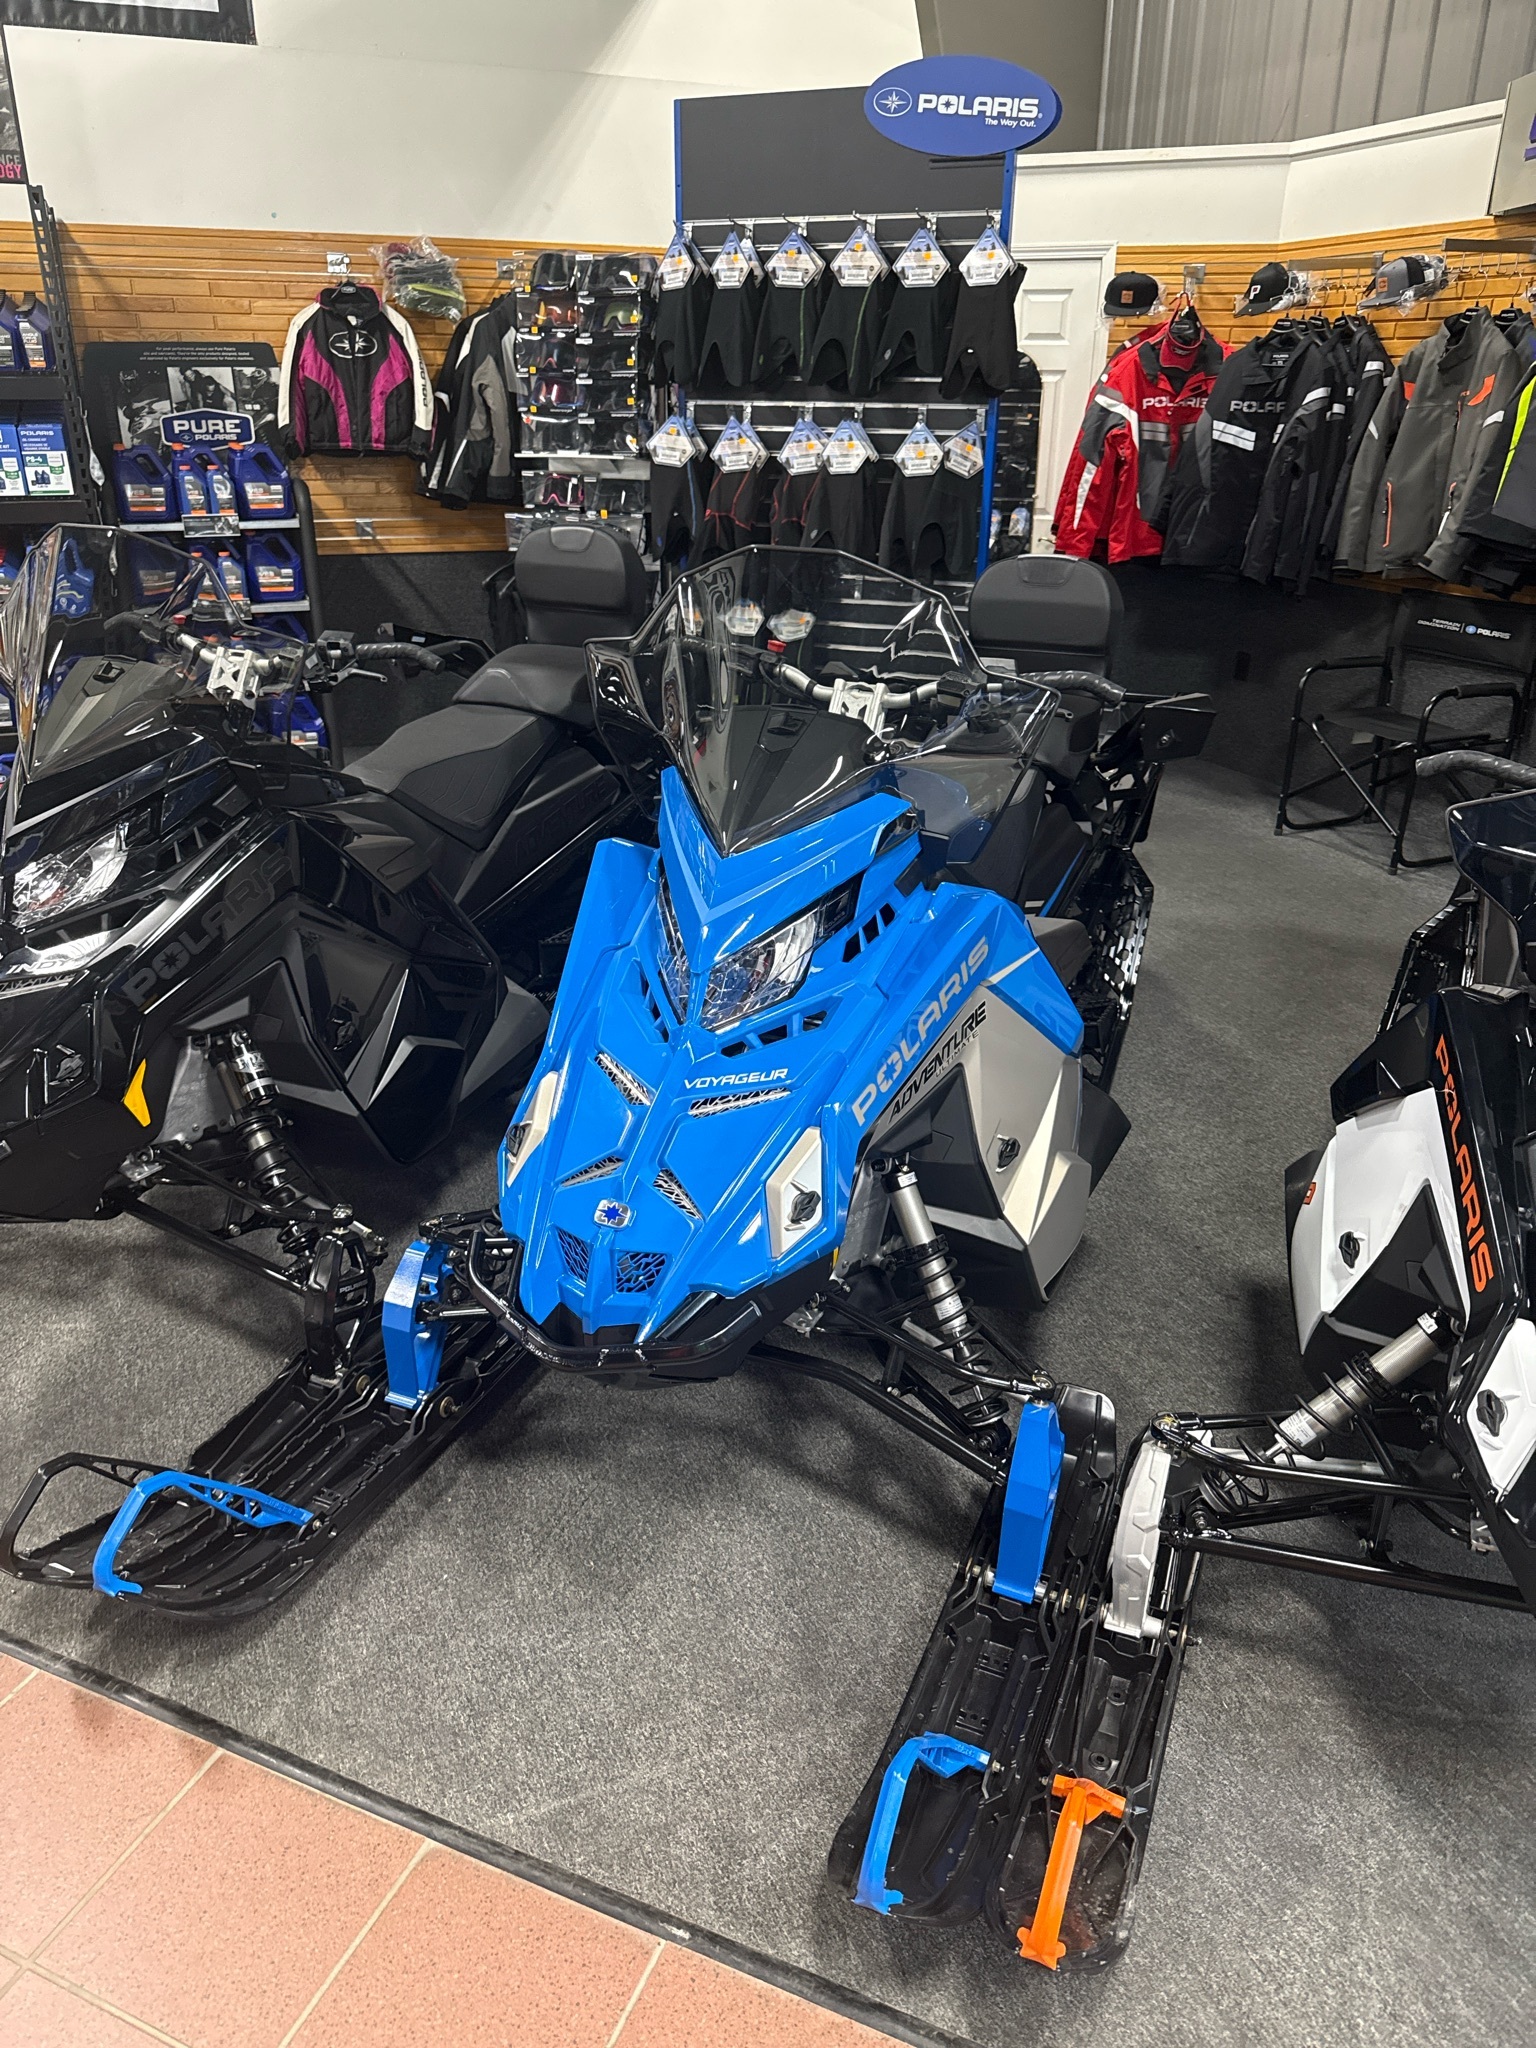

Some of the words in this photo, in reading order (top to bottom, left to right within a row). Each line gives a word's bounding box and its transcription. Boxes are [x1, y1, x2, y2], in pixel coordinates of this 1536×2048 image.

[917, 93, 1040, 118] POLARIS
[985, 118, 998, 126] The
[1000, 118, 1017, 128] Way
[1250, 285, 1261, 299] P
[172, 419, 241, 434] PURE
[194, 433, 238, 441] POLARIS
[1417, 620, 1460, 631] DOMINATION
[1432, 618, 1461, 627] TERRAIN
[1477, 627, 1511, 640] POLARIS
[121, 848, 293, 1007] POLARIS
[5, 960, 67, 975] INDY
[852, 935, 989, 1127] POLARIS
[935, 1030, 979, 1078] ULTIMATE
[888, 1001, 987, 1124] ADVENTURE
[684, 1068, 789, 1089] VOYAGEUR
[1435, 1034, 1495, 1292] POLARIS
